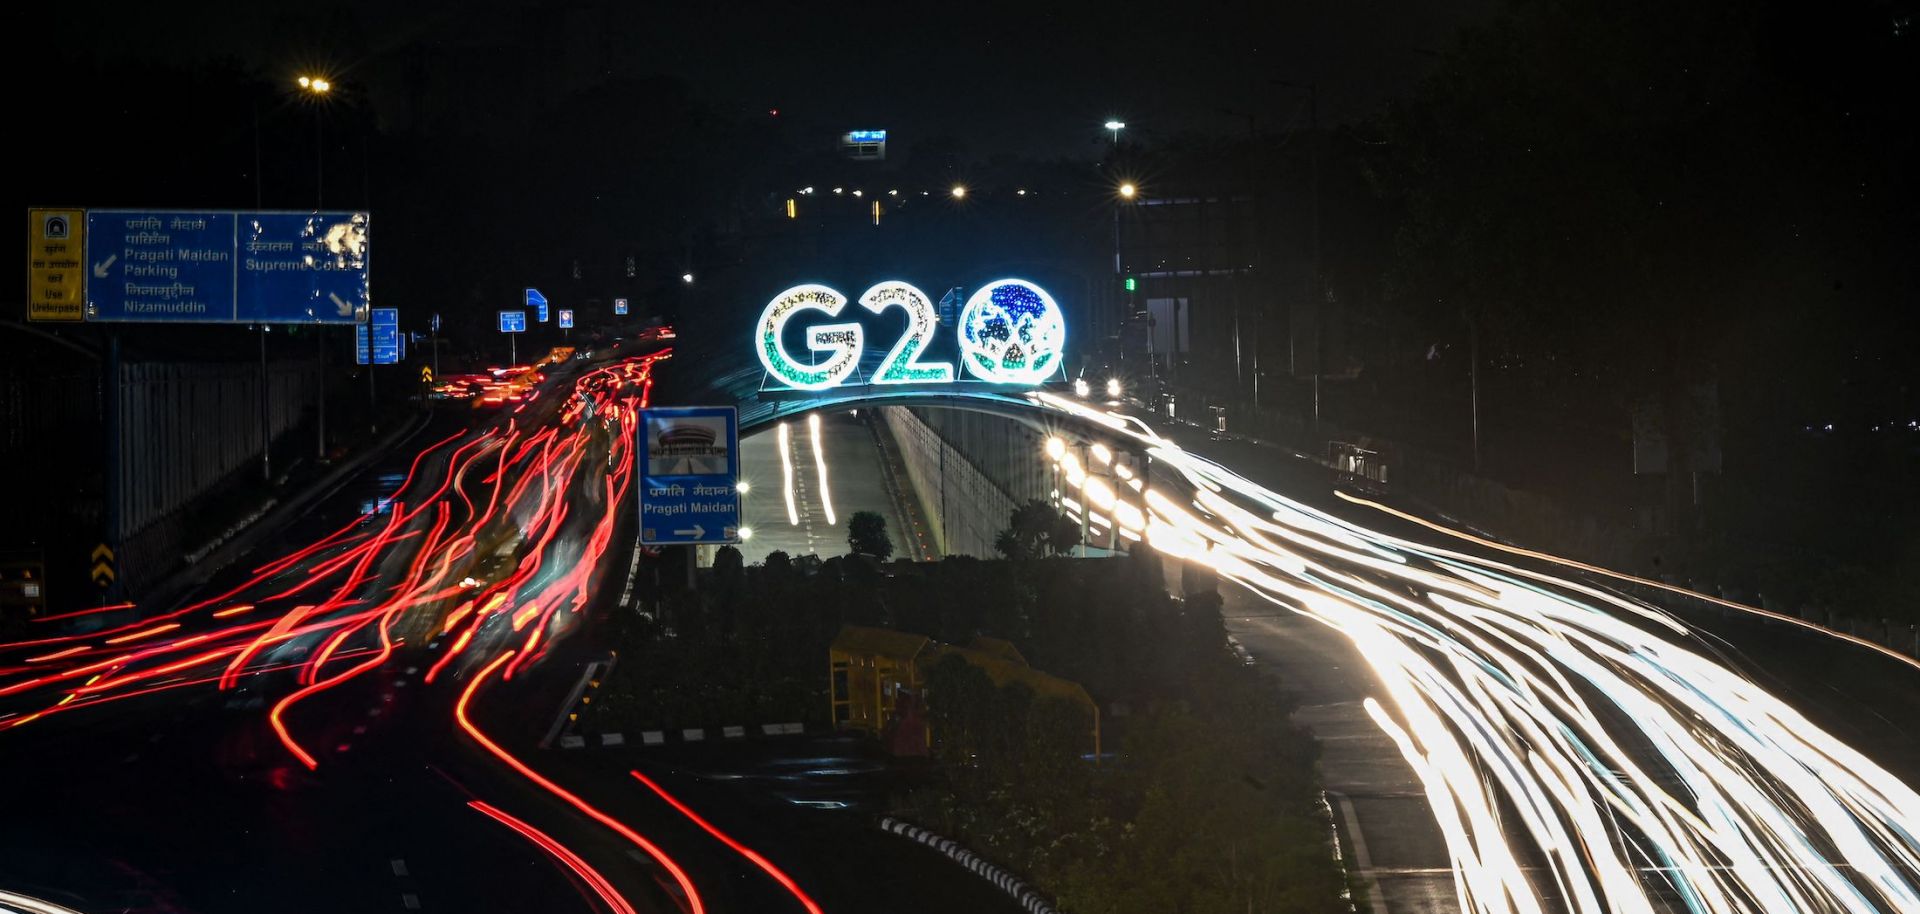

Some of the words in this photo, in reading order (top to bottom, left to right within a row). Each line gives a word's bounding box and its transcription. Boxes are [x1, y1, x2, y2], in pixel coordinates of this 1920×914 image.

[124, 248, 174, 264] Pragati
[178, 248, 229, 262] Maidan
[124, 264, 178, 280] Parking
[245, 258, 309, 273] Supreme
[45, 288, 63, 299] Use
[32, 302, 79, 313] Underpass
[124, 300, 206, 314] Nizamuddin
[643, 502, 687, 516] Pragati
[690, 502, 736, 513] Maidan
